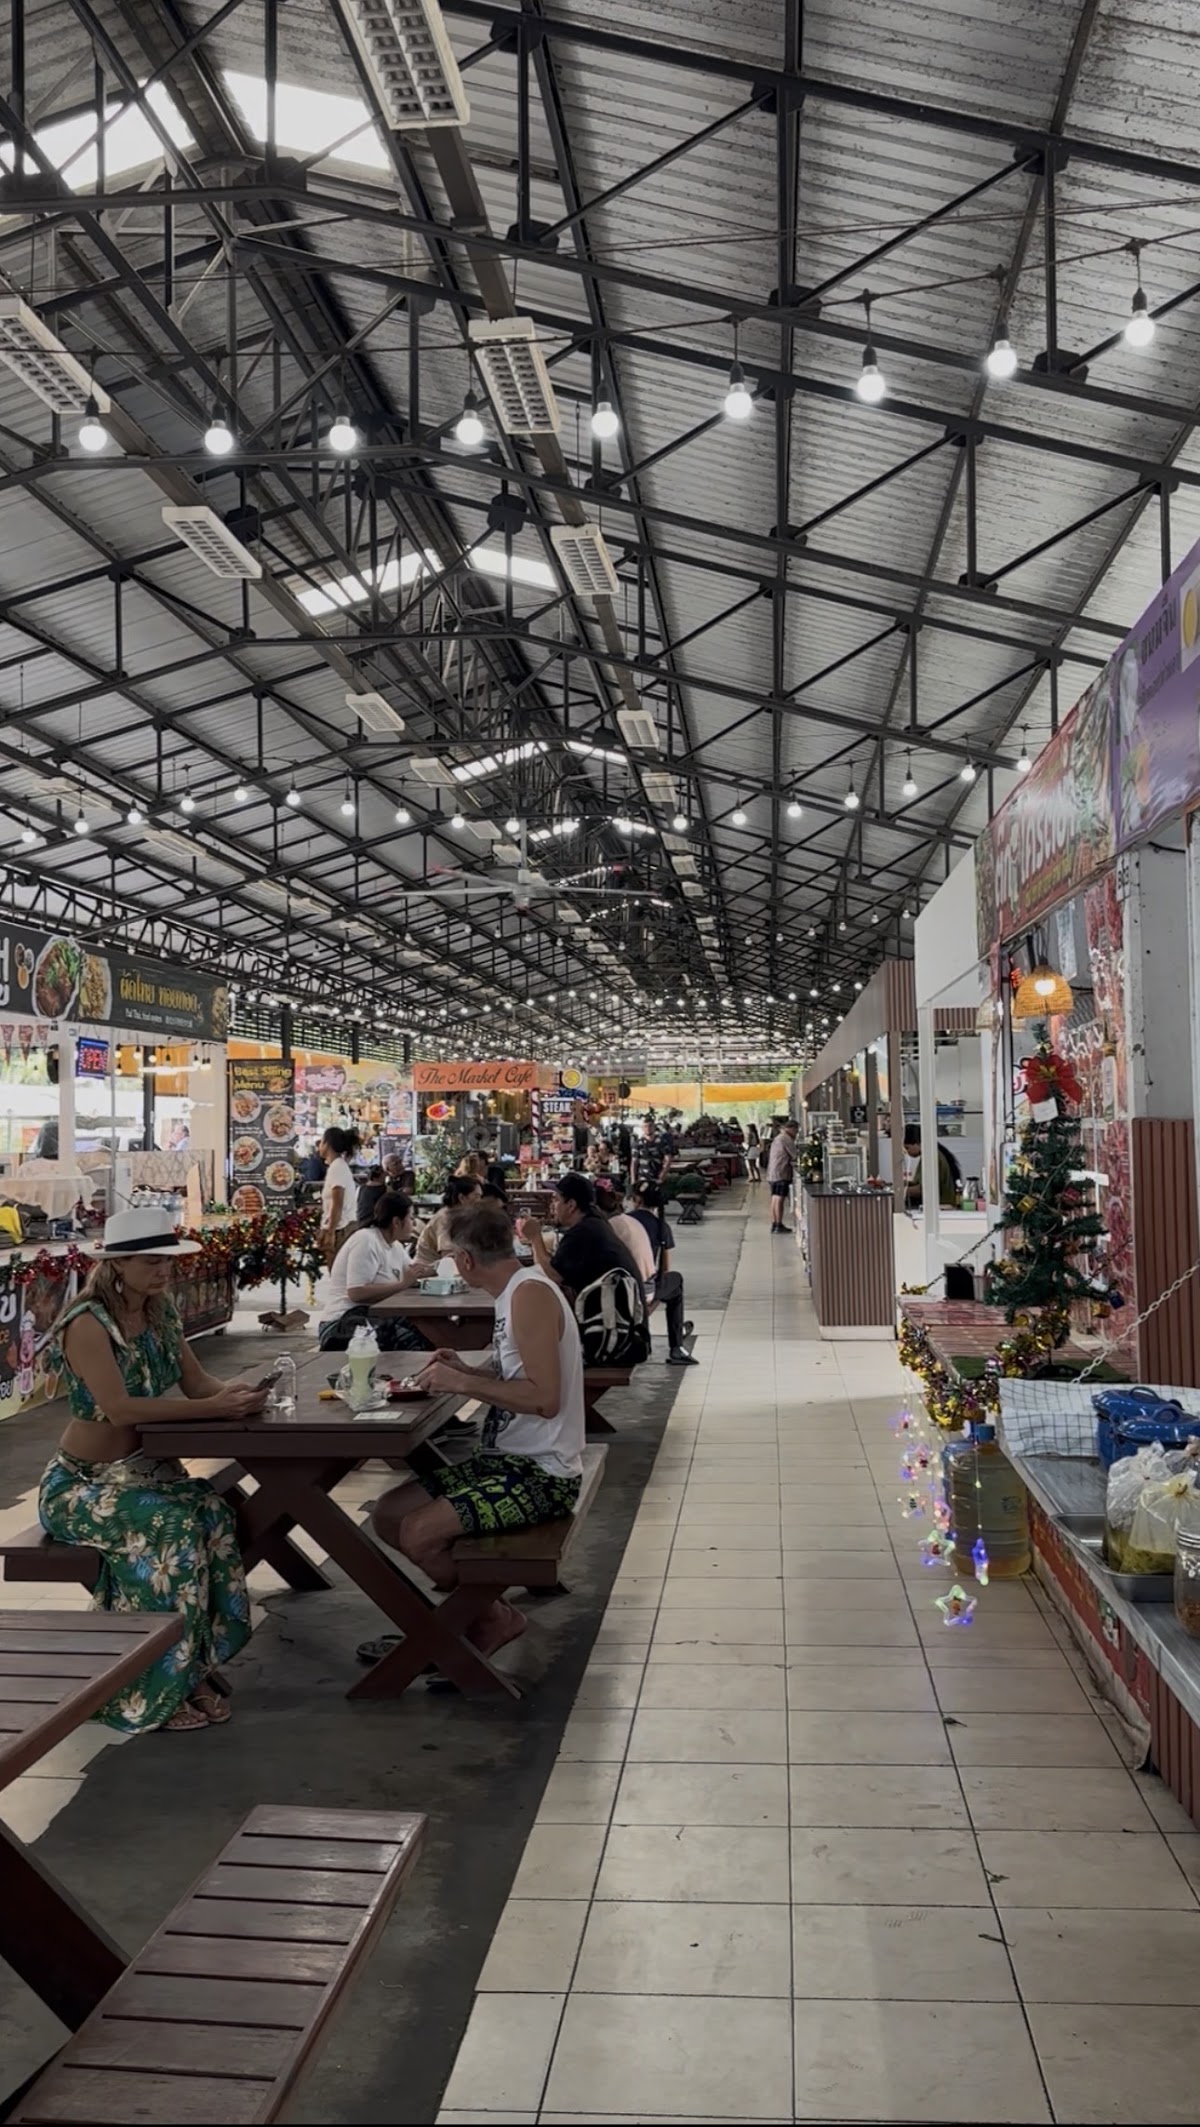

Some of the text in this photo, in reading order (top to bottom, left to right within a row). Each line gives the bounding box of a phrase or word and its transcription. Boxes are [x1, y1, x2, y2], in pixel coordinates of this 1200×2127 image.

[418, 1067, 446, 1085] The
[447, 1067, 502, 1085] Market
[234, 1080, 265, 1089] Menu
[543, 1101, 572, 1113] STEAK
